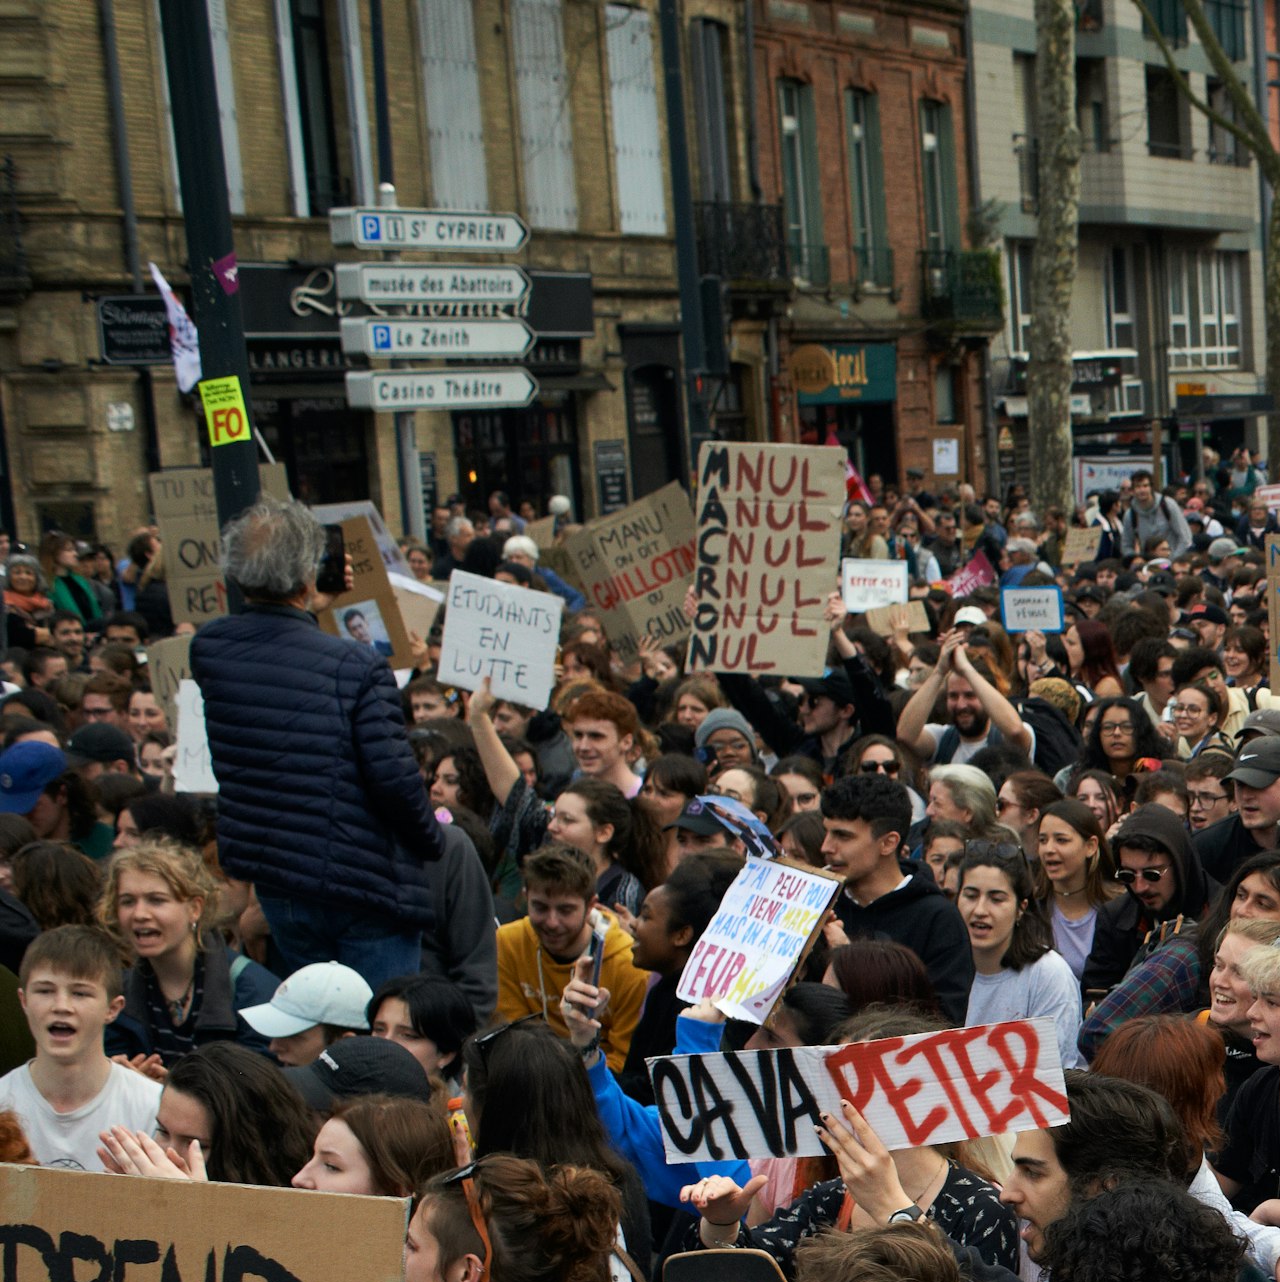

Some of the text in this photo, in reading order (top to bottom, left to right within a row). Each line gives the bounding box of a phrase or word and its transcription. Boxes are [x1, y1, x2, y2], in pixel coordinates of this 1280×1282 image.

[436, 220, 506, 241] CYPRIEN
[368, 273, 513, 293] musée des Abattoirs
[397, 329, 413, 347] Le
[421, 327, 470, 347] Zénith
[379, 379, 503, 400] Casino Théâtre
[212, 407, 243, 442] FO
[452, 585, 554, 634] ETUDIANTS
[479, 627, 510, 651] EN
[453, 649, 528, 689] LUTTE
[825, 1019, 1070, 1146] PETER
